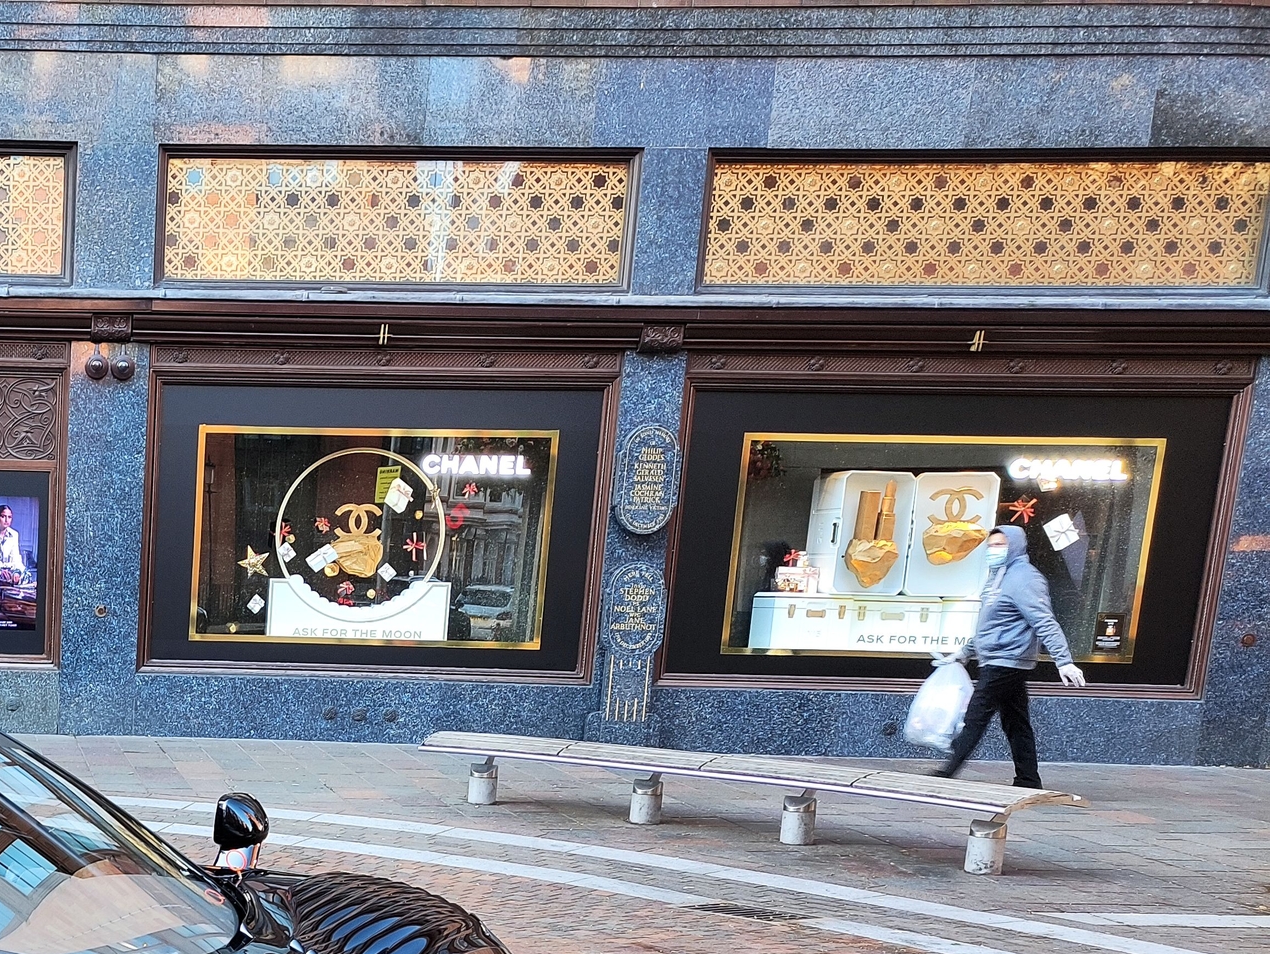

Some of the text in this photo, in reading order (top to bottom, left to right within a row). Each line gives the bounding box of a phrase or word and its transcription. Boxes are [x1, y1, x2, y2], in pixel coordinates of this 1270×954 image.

[421, 453, 532, 476] CHANEL
[1008, 457, 1128, 481] CHANEL
[624, 570, 654, 582] HERE FELL
[614, 605, 635, 613] NOEL
[292, 627, 422, 639] ASK FOR THE MOON
[610, 623, 657, 631] ARBUTHNOT
[856, 634, 974, 646] ASK FOR THE MO
